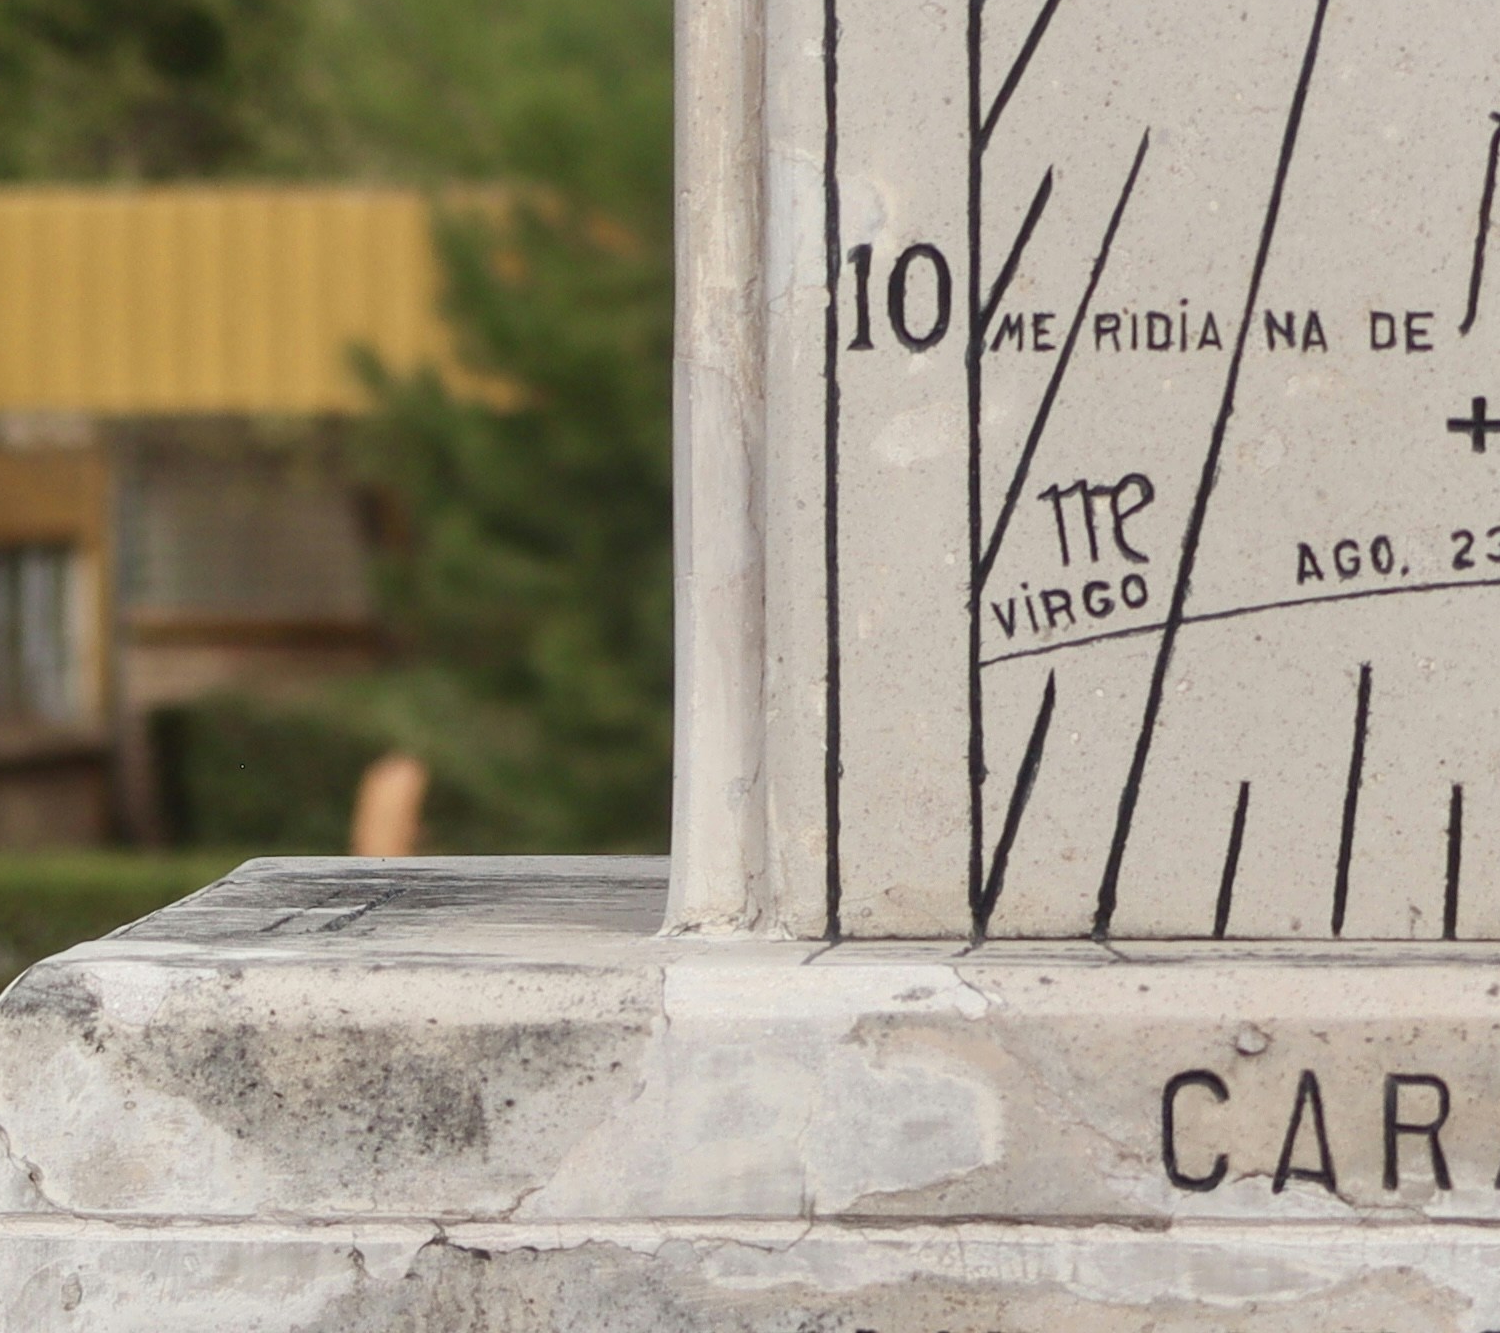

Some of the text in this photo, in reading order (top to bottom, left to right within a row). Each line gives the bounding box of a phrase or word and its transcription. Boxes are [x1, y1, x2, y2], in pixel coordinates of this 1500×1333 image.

[847, 242, 953, 352] 10
[1369, 309, 1437, 353] DE
[1296, 535, 1411, 586] AGO.
